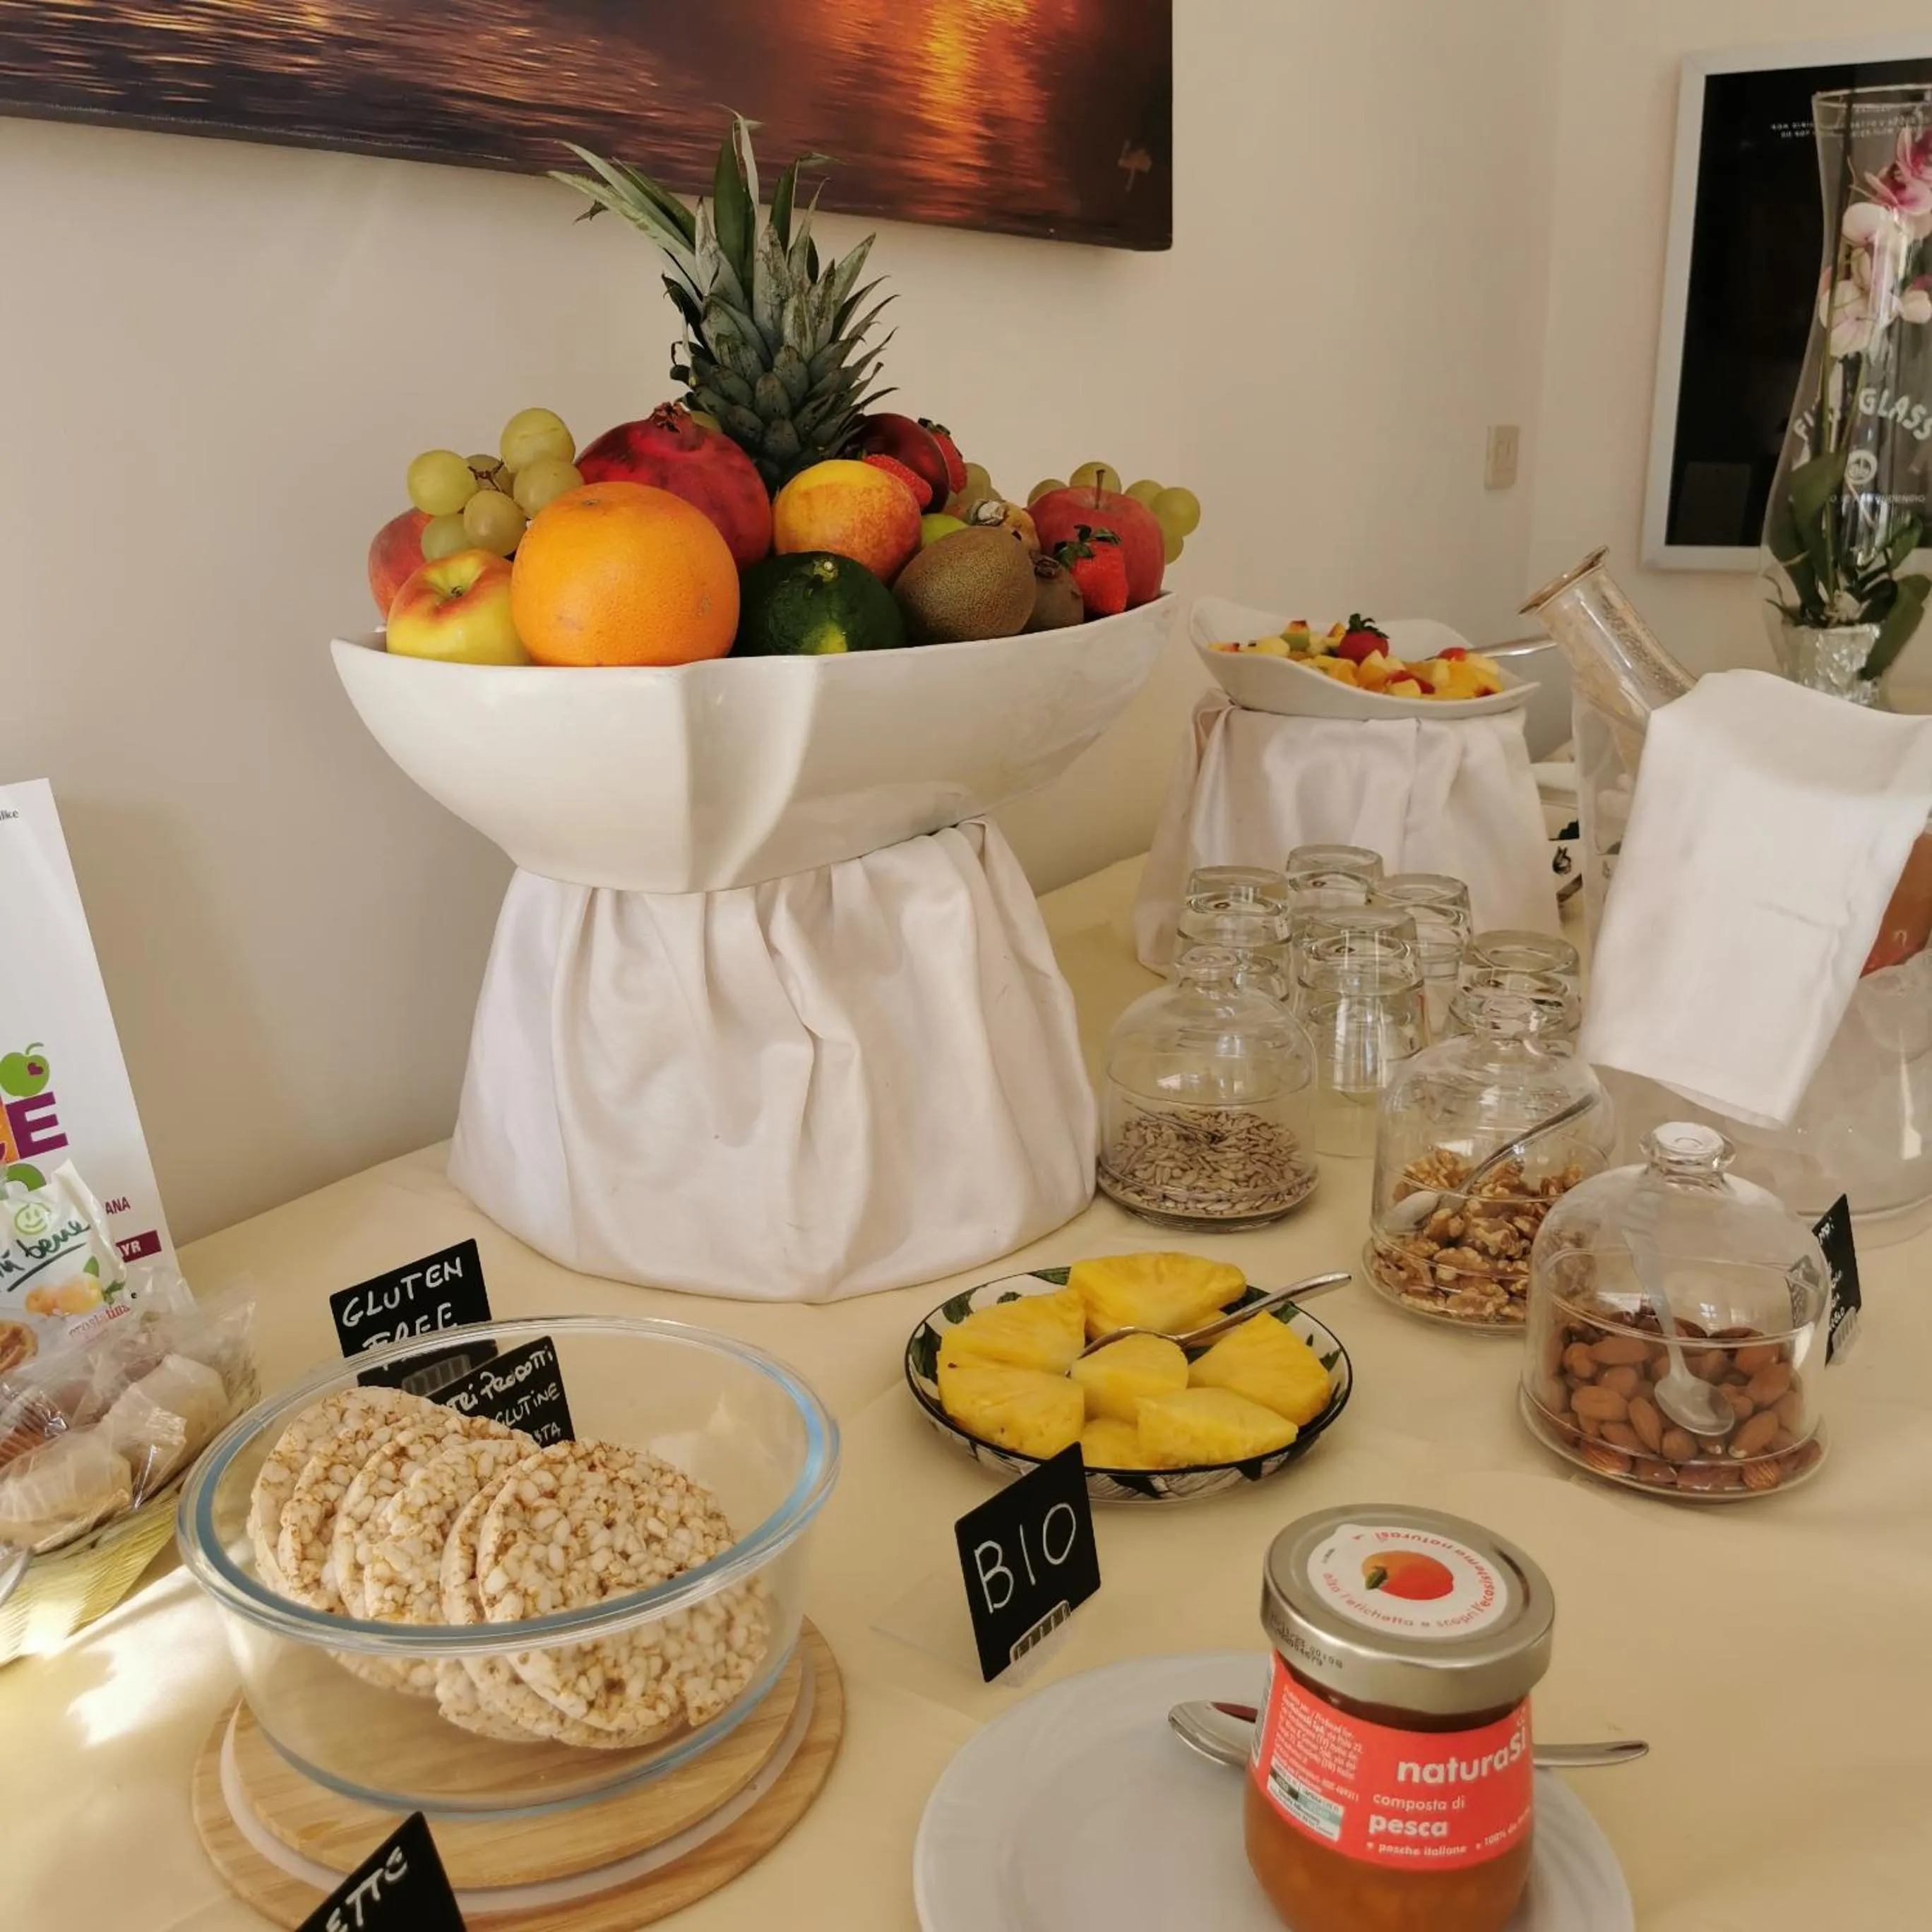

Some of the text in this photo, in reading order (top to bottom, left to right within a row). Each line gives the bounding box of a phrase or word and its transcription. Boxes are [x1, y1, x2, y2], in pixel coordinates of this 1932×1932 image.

[1859, 388, 1932, 440] GLASS
[342, 1256, 464, 1328] GLUTEN
[974, 1502, 1077, 1614] BIO
[1372, 1794, 1465, 1813] composta di
[1368, 1814, 1448, 1836] pesca
[1378, 1843, 1467, 1856] pesche italiane
